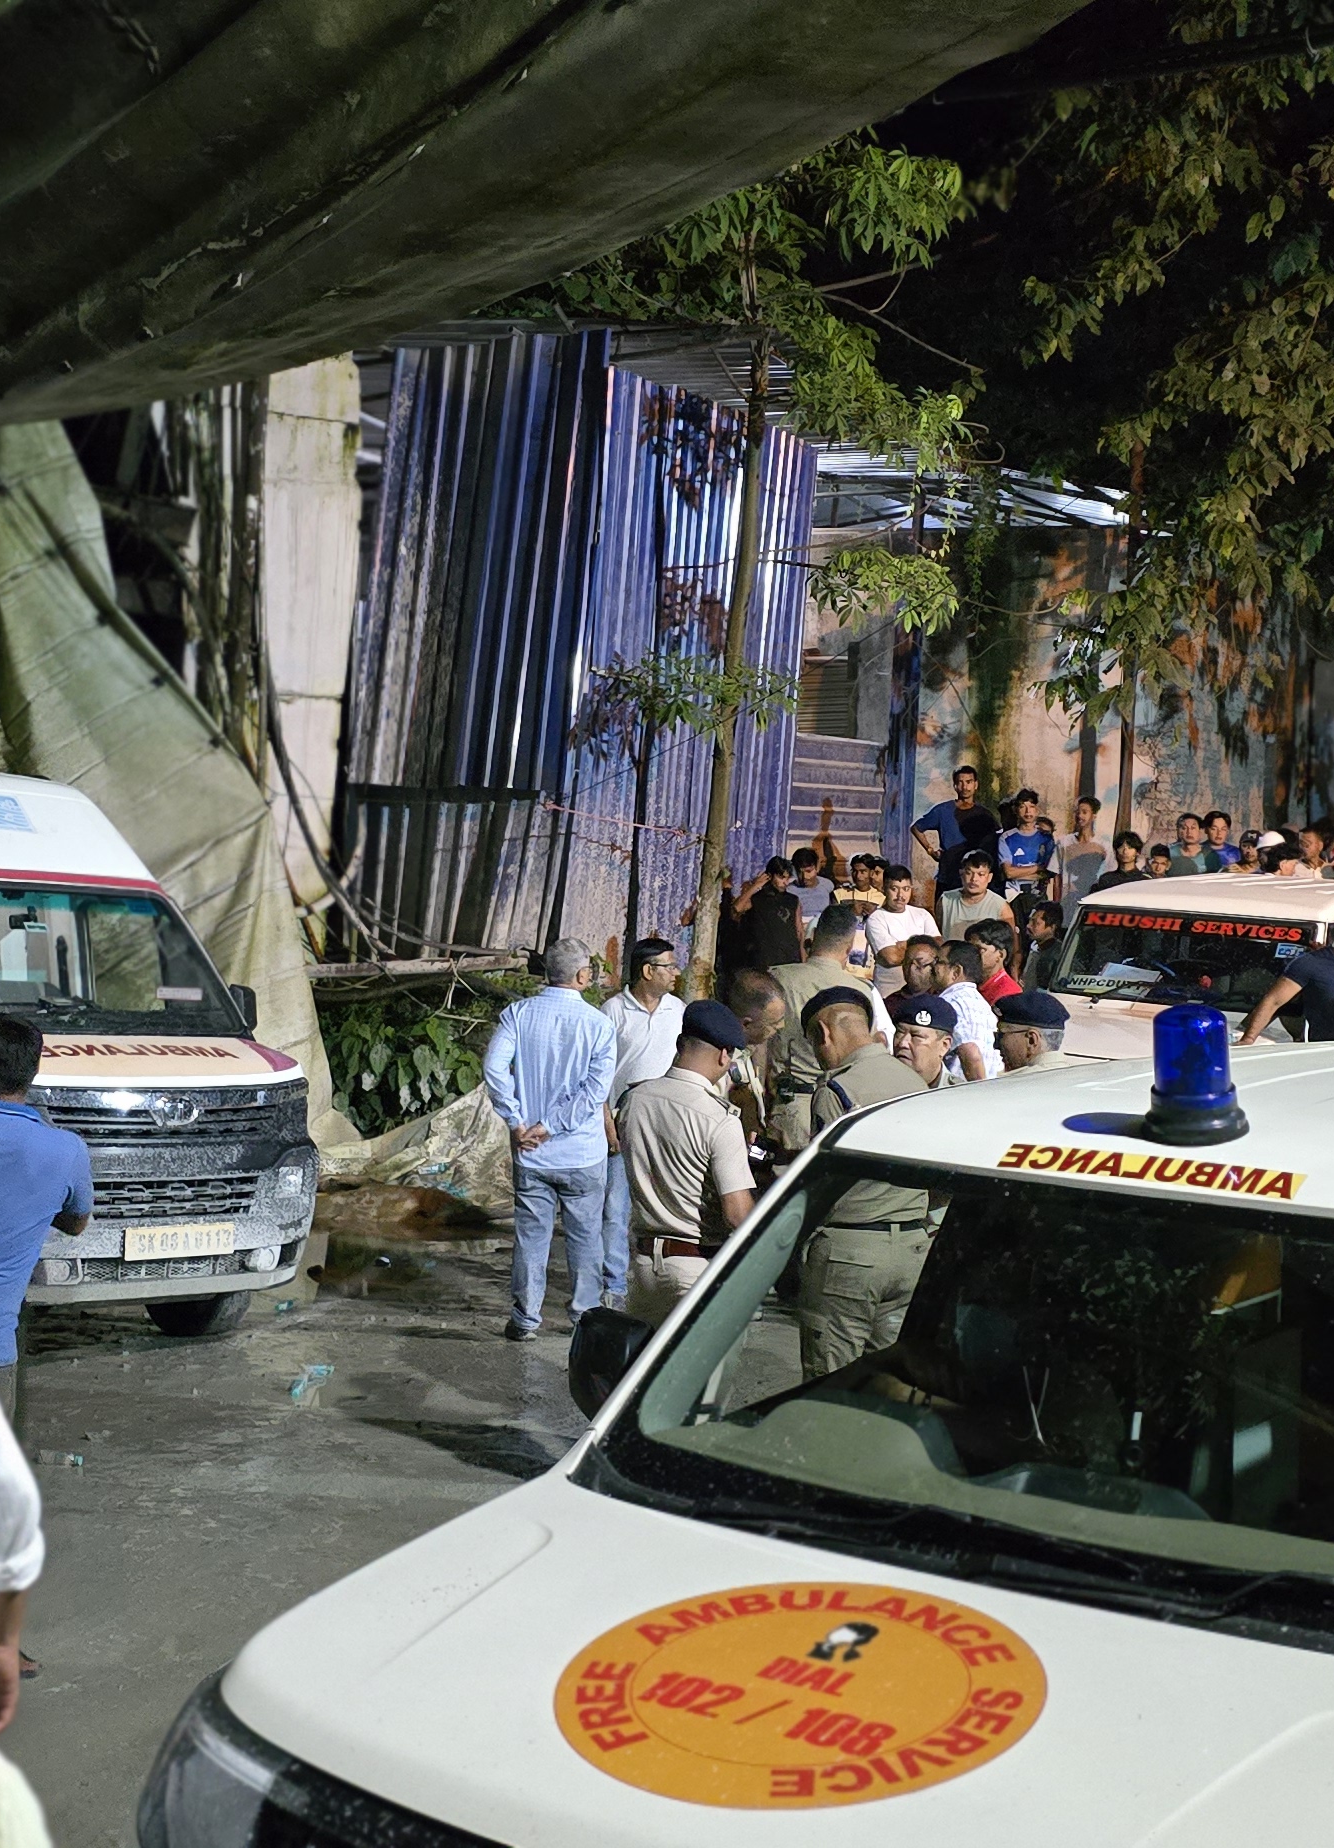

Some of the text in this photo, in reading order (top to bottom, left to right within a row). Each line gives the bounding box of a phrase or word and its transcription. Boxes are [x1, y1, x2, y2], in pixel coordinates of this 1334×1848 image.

[1085, 911, 1303, 942] KHUSHI SERVICES
[576, 1589, 1024, 1797] FREE AMBULANCE SERVICE
[756, 1655, 856, 1697] DIAL
[637, 1670, 746, 1719] 102
[783, 1706, 898, 1758] 108
